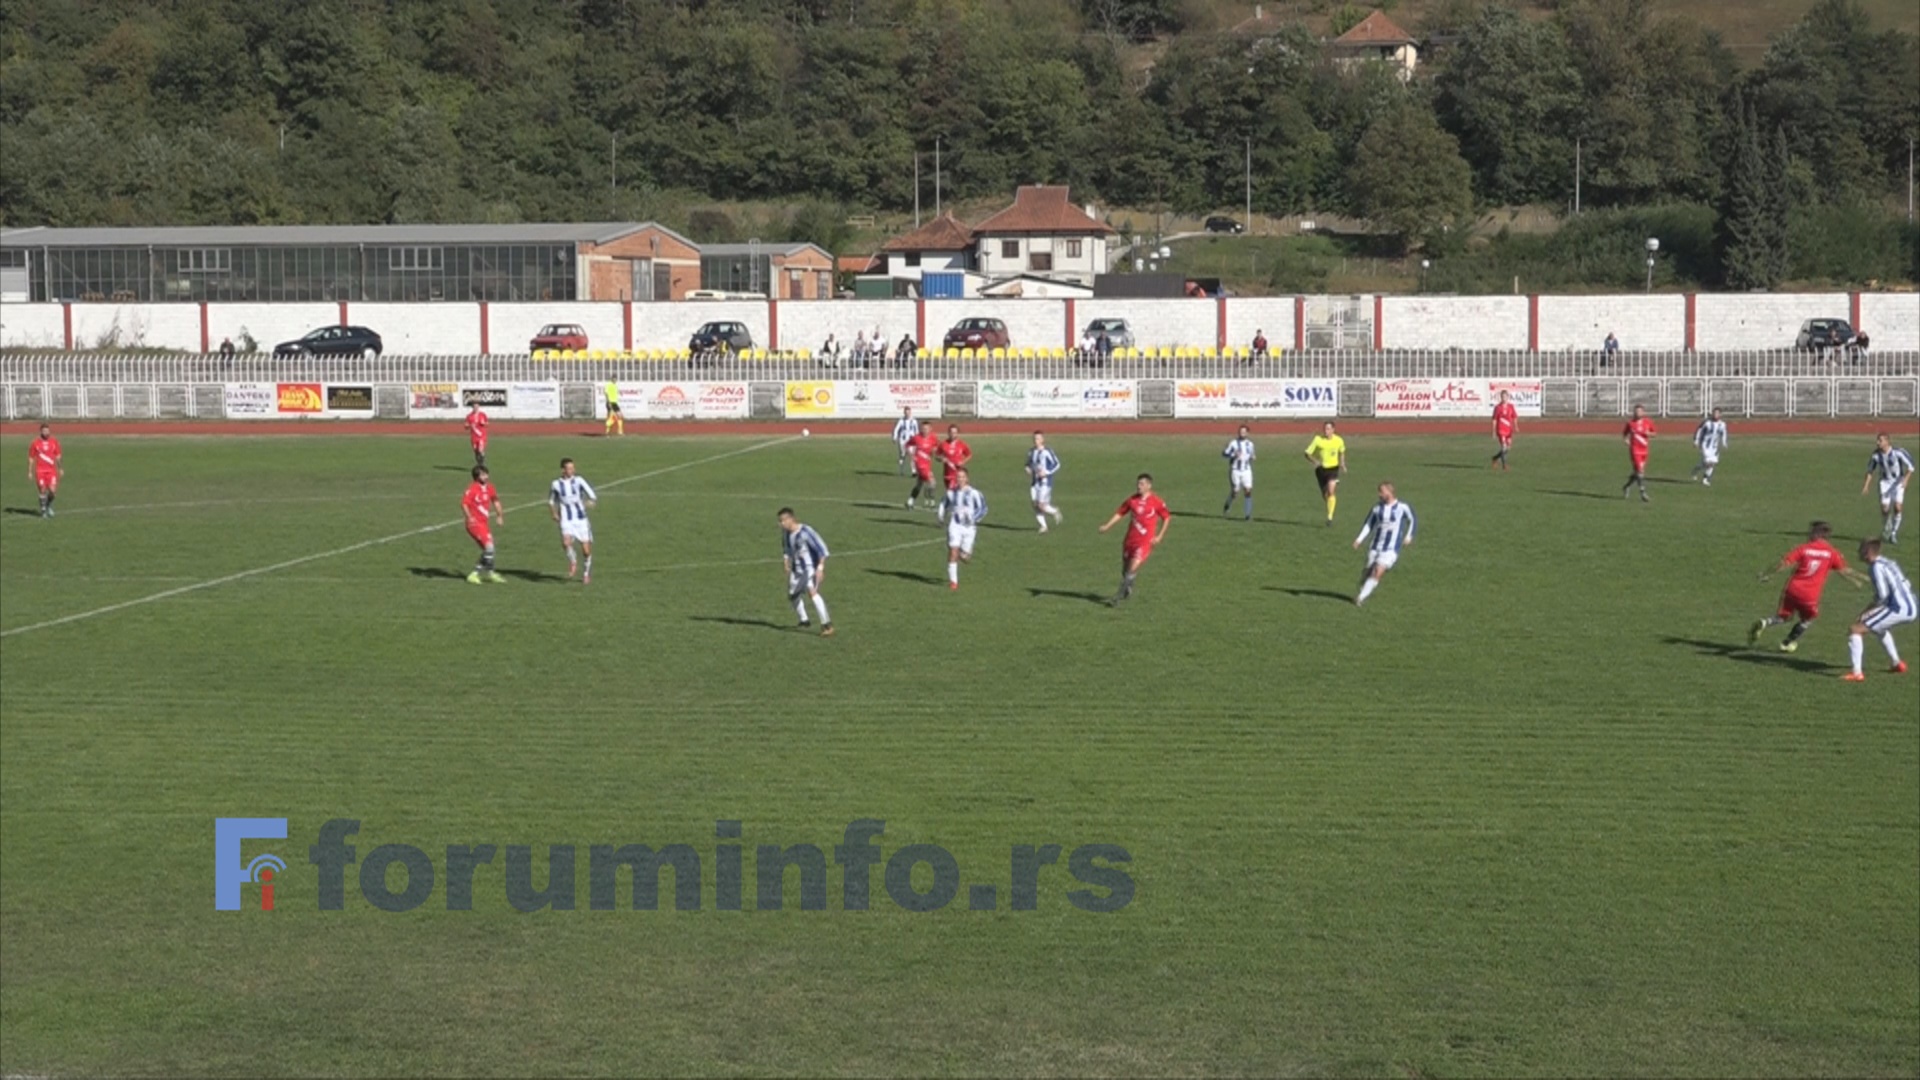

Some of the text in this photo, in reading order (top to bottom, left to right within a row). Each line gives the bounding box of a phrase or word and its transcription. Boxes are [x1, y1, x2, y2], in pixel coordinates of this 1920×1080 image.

[708, 386, 745, 397] JONA
[1285, 387, 1334, 402] SOVA
[1398, 393, 1431, 401] SALON
